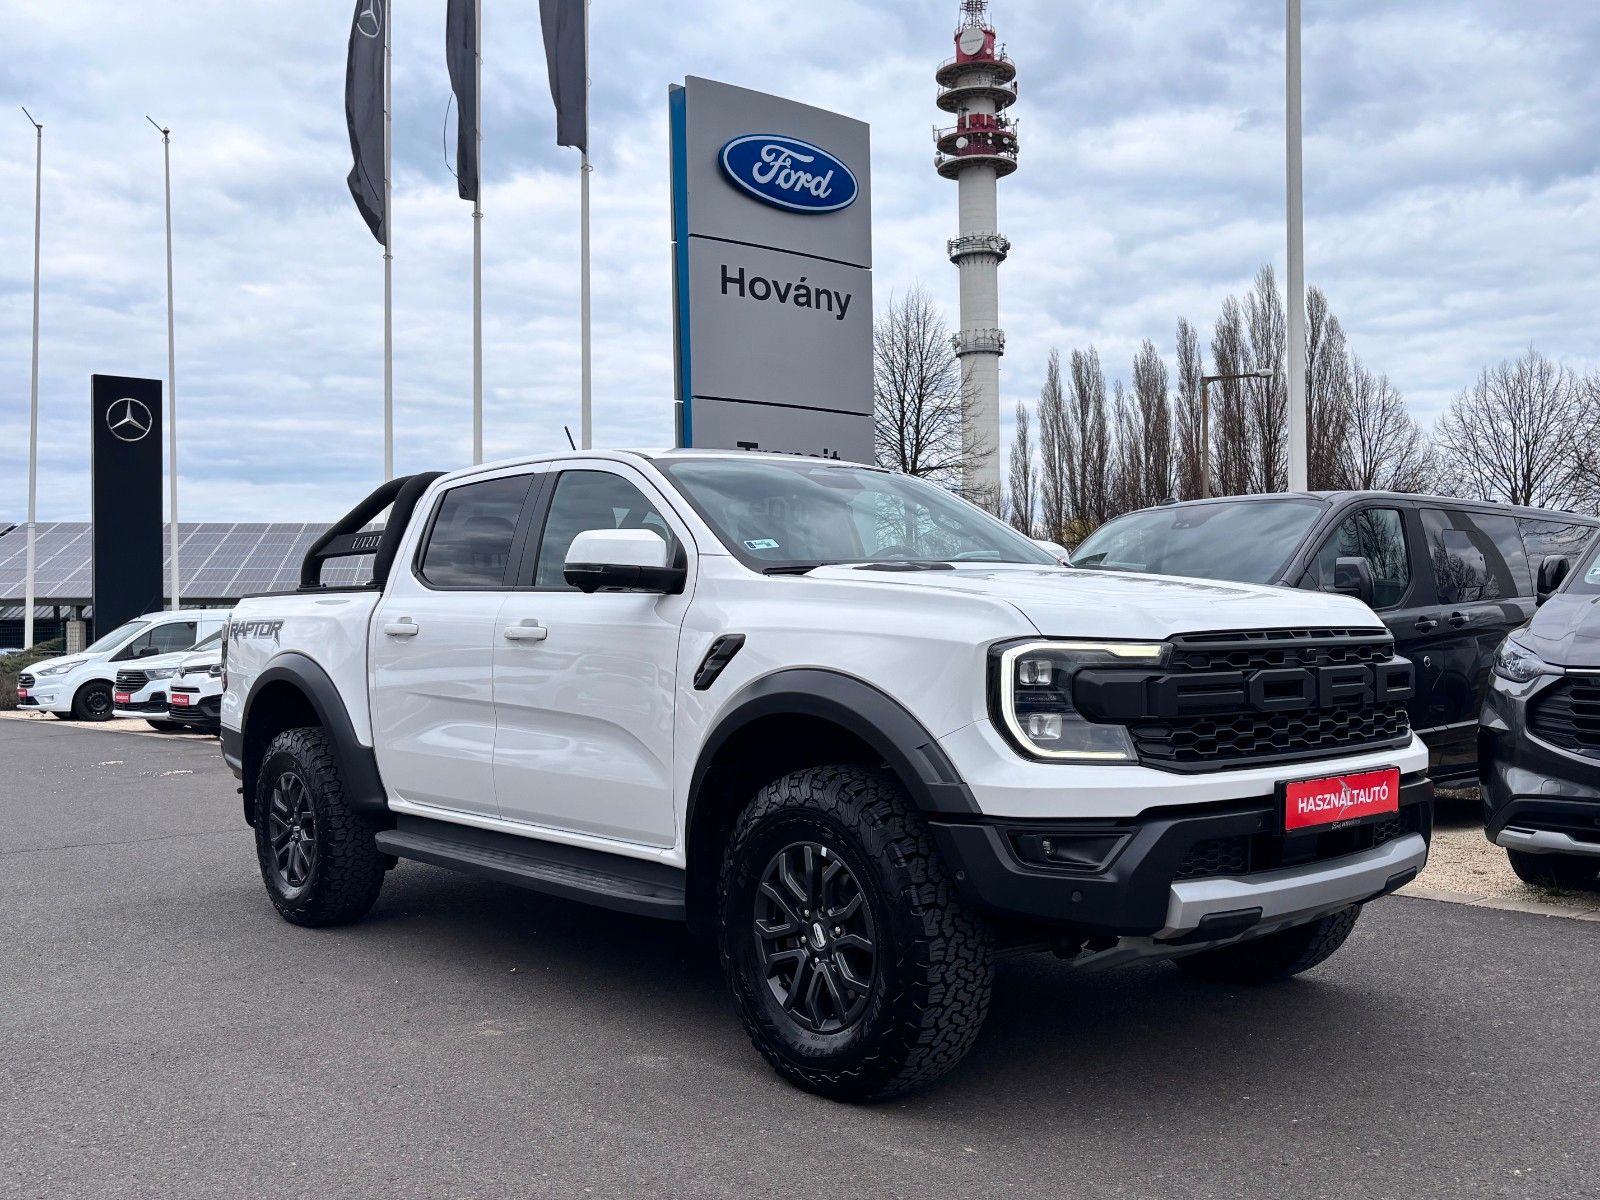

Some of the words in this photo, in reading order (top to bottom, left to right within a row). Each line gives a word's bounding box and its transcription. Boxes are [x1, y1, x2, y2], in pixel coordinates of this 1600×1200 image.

[752, 144, 834, 198] Ford
[720, 264, 852, 320] Hovány
[229, 620, 285, 648] RAPTOR
[1152, 659, 1416, 717] FORD
[1298, 781, 1390, 814] HASZNÁLTAUTÓ
